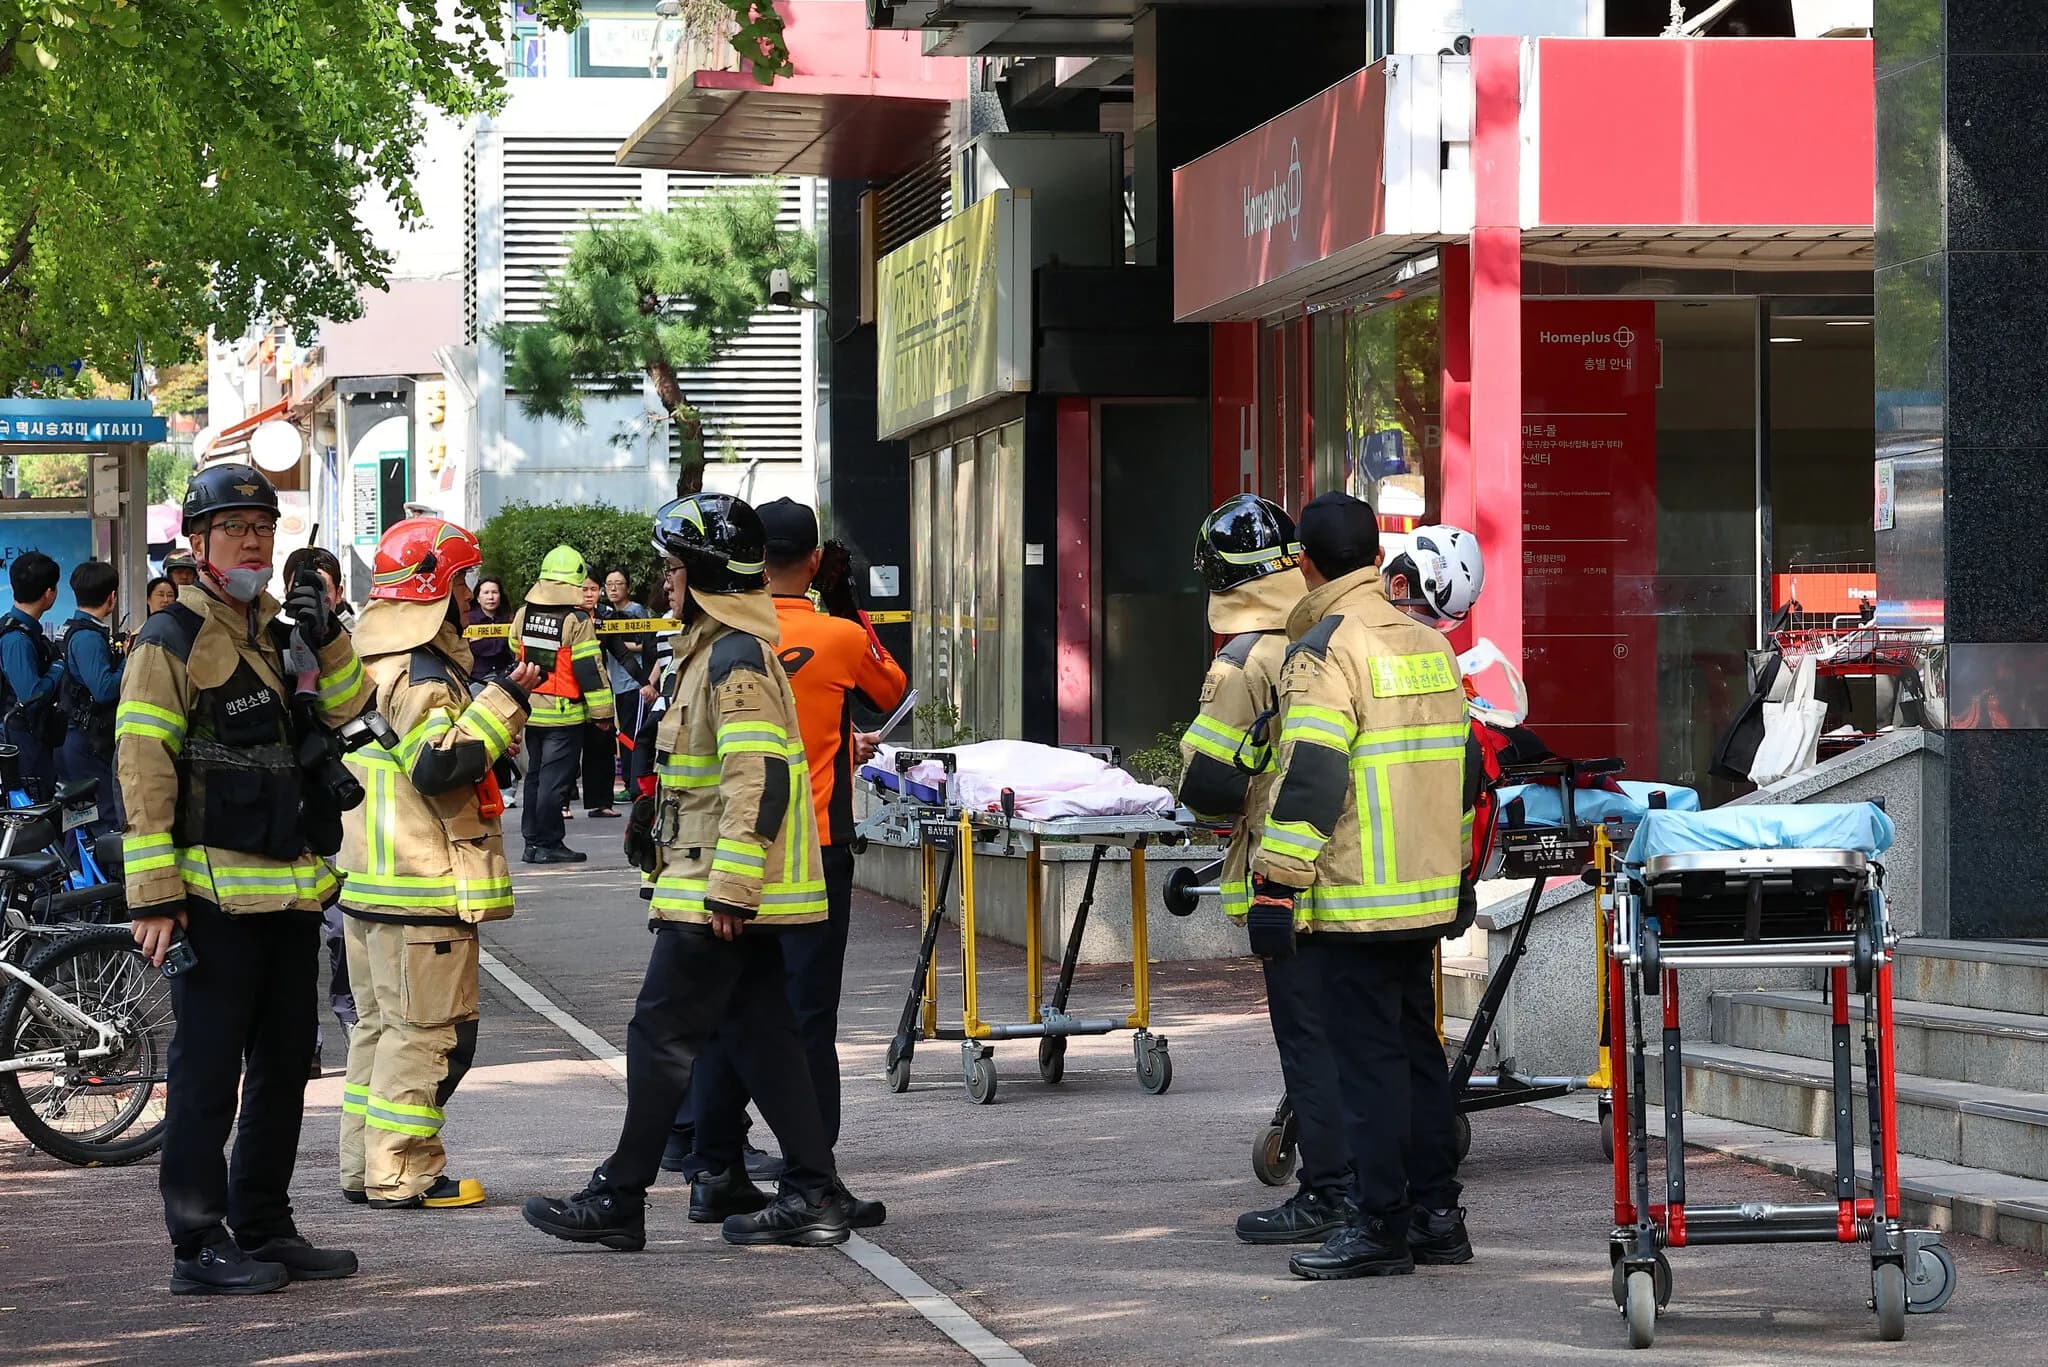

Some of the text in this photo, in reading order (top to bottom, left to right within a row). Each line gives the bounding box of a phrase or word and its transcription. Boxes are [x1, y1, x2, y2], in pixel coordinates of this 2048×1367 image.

[1243, 170, 1287, 241] Homeplus
[1540, 331, 1611, 346] Homeplus
[1584, 358, 1632, 371] 층별 안내
[95, 423, 142, 436] (TAXI)
[477, 626, 490, 636] FIRE
[490, 626, 503, 636] LINE
[607, 622, 619, 631] LINE
[225, 688, 271, 716] 인천소방
